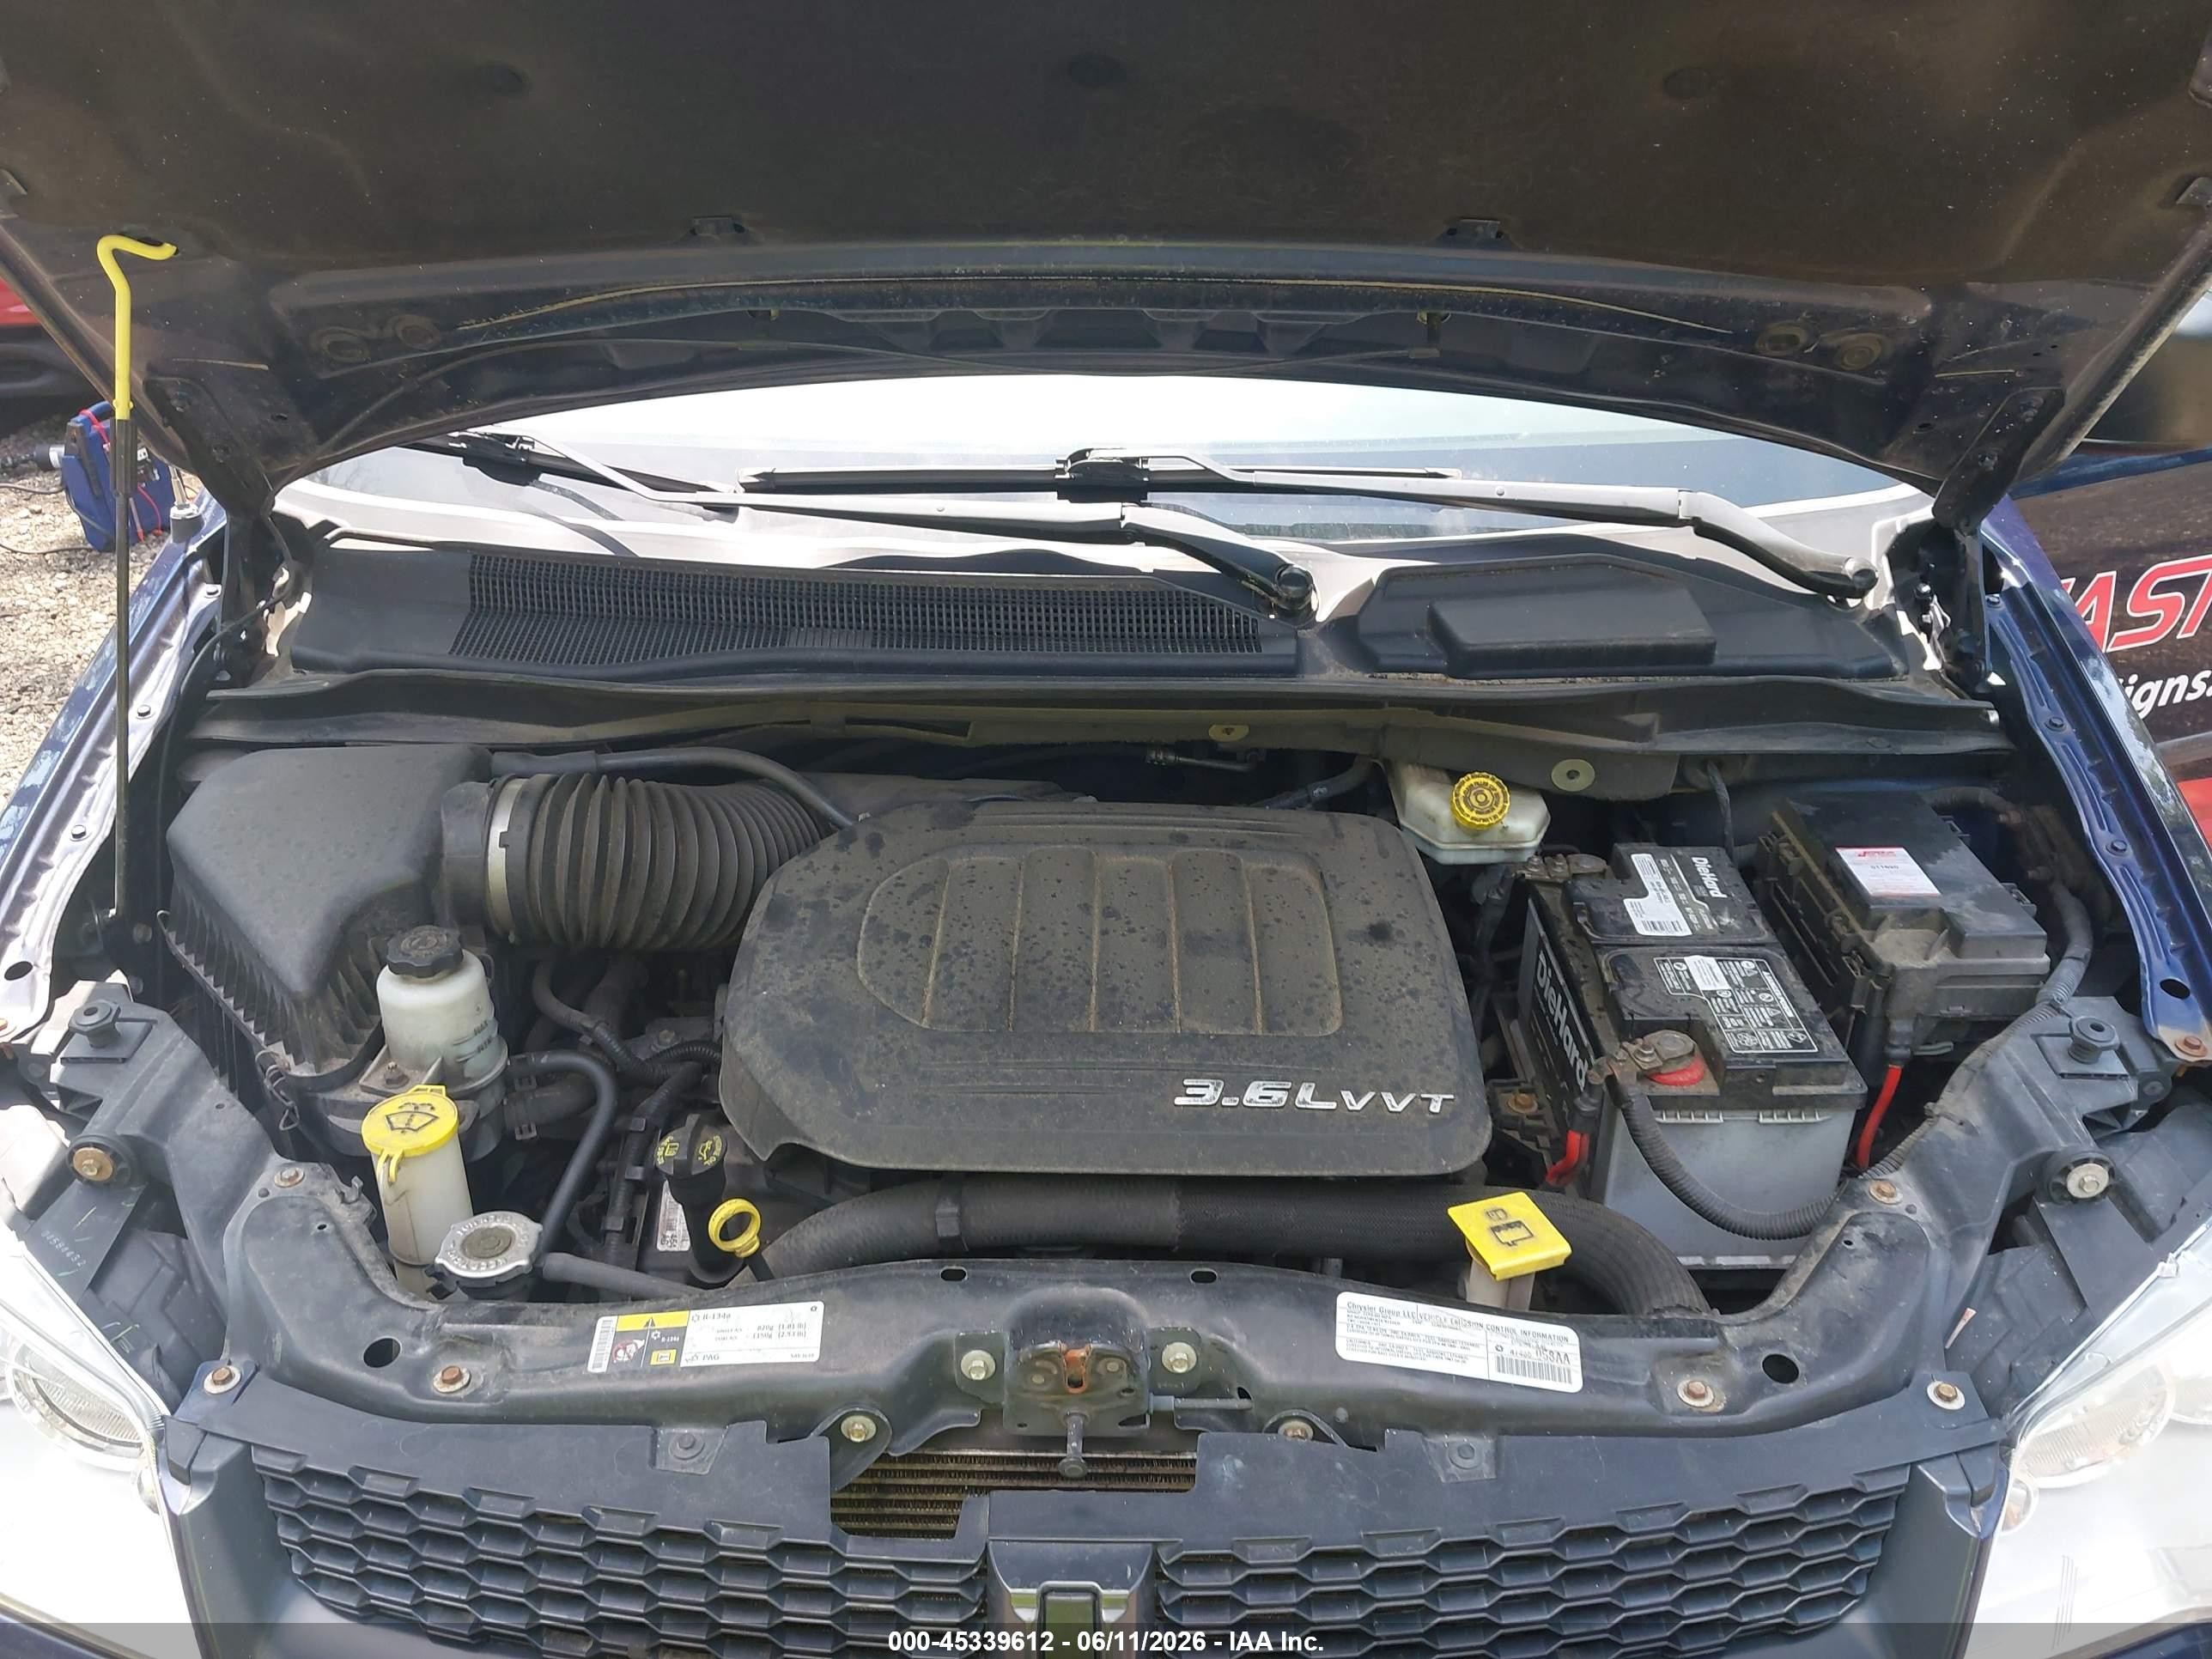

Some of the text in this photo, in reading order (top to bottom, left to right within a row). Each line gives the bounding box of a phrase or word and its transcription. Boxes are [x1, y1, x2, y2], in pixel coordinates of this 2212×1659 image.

[2060, 553, 2212, 653] AST
[2118, 669, 2212, 720] igns.
[1691, 856, 1729, 898] DieHard
[1534, 948, 1589, 1090] DieHard
[1346, 1301, 1378, 1313] Chrysler
[1378, 1306, 1401, 1318] Group
[1402, 1309, 1416, 1319] LLC
[1486, 1322, 1516, 1335] CONTROL
[1520, 1328, 1570, 1343] INFORMATION
